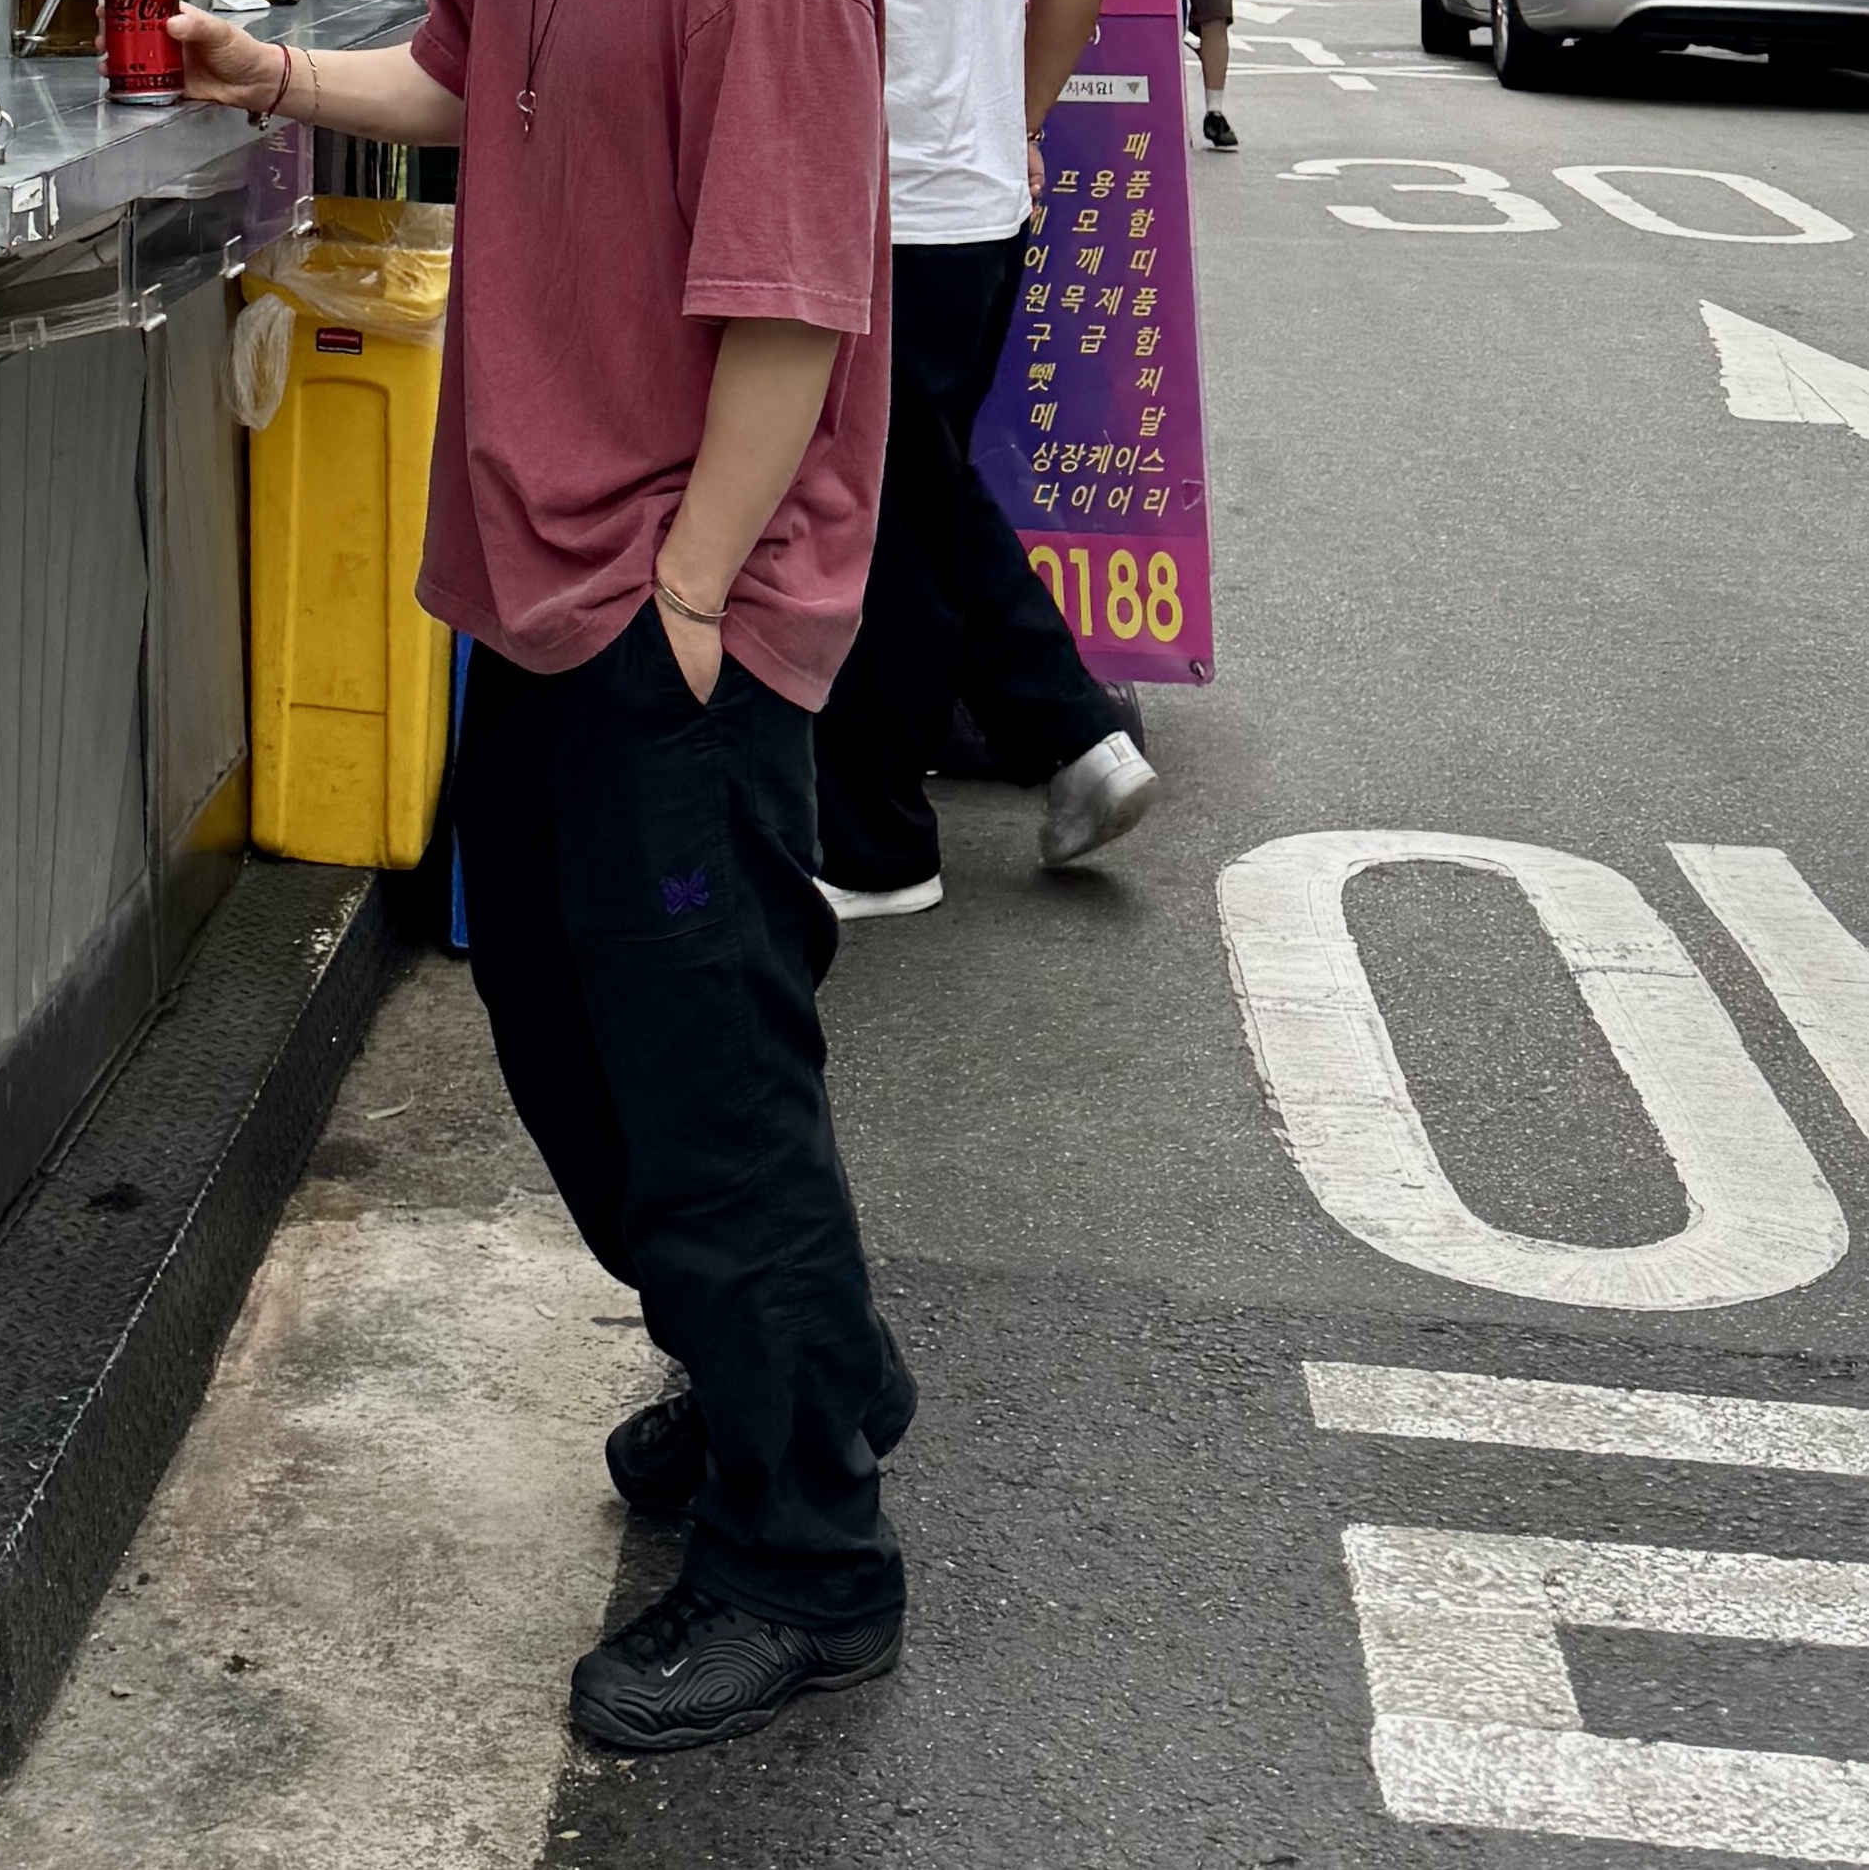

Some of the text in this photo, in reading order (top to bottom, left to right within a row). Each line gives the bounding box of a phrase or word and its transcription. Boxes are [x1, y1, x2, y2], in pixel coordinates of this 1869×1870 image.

[1123, 132, 1151, 161] 패
[1276, 157, 1855, 244] 30
[1025, 282, 1159, 316] 원목제품
[1027, 323, 1162, 357] 구급함
[1030, 401, 1166, 437] 메달
[1032, 442, 1166, 476] 상장케이스
[1033, 482, 1171, 518] 다이어리
